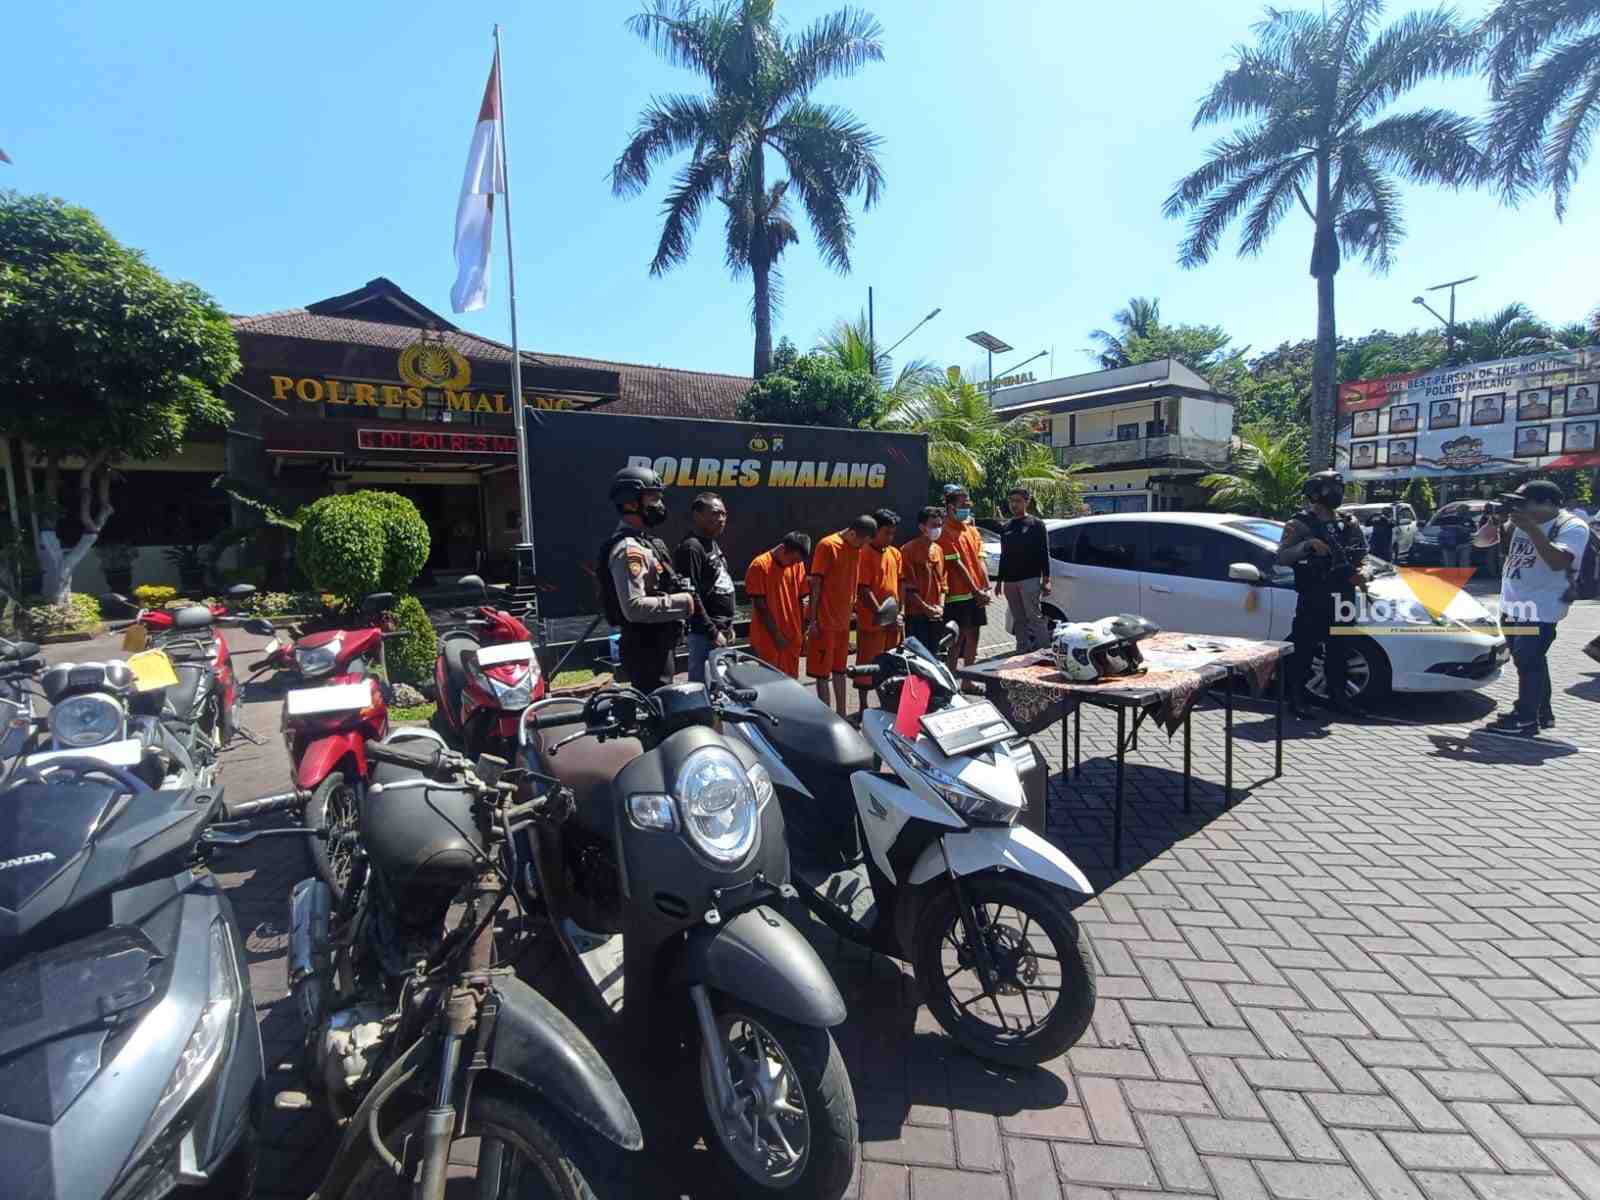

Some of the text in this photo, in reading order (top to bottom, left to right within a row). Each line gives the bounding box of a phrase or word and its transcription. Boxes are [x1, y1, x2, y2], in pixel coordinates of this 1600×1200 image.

[1407, 378, 1431, 390] BEST
[1433, 370, 1476, 387] PERSON
[1478, 369, 1495, 379] OF
[1496, 366, 1518, 377] THE
[1519, 359, 1563, 374] MONTH
[1425, 376, 1513, 397] POLRES MALANG
[270, 375, 424, 409] POLRES
[767, 459, 887, 489] MALANG
[0, 851, 57, 870] ONDA
